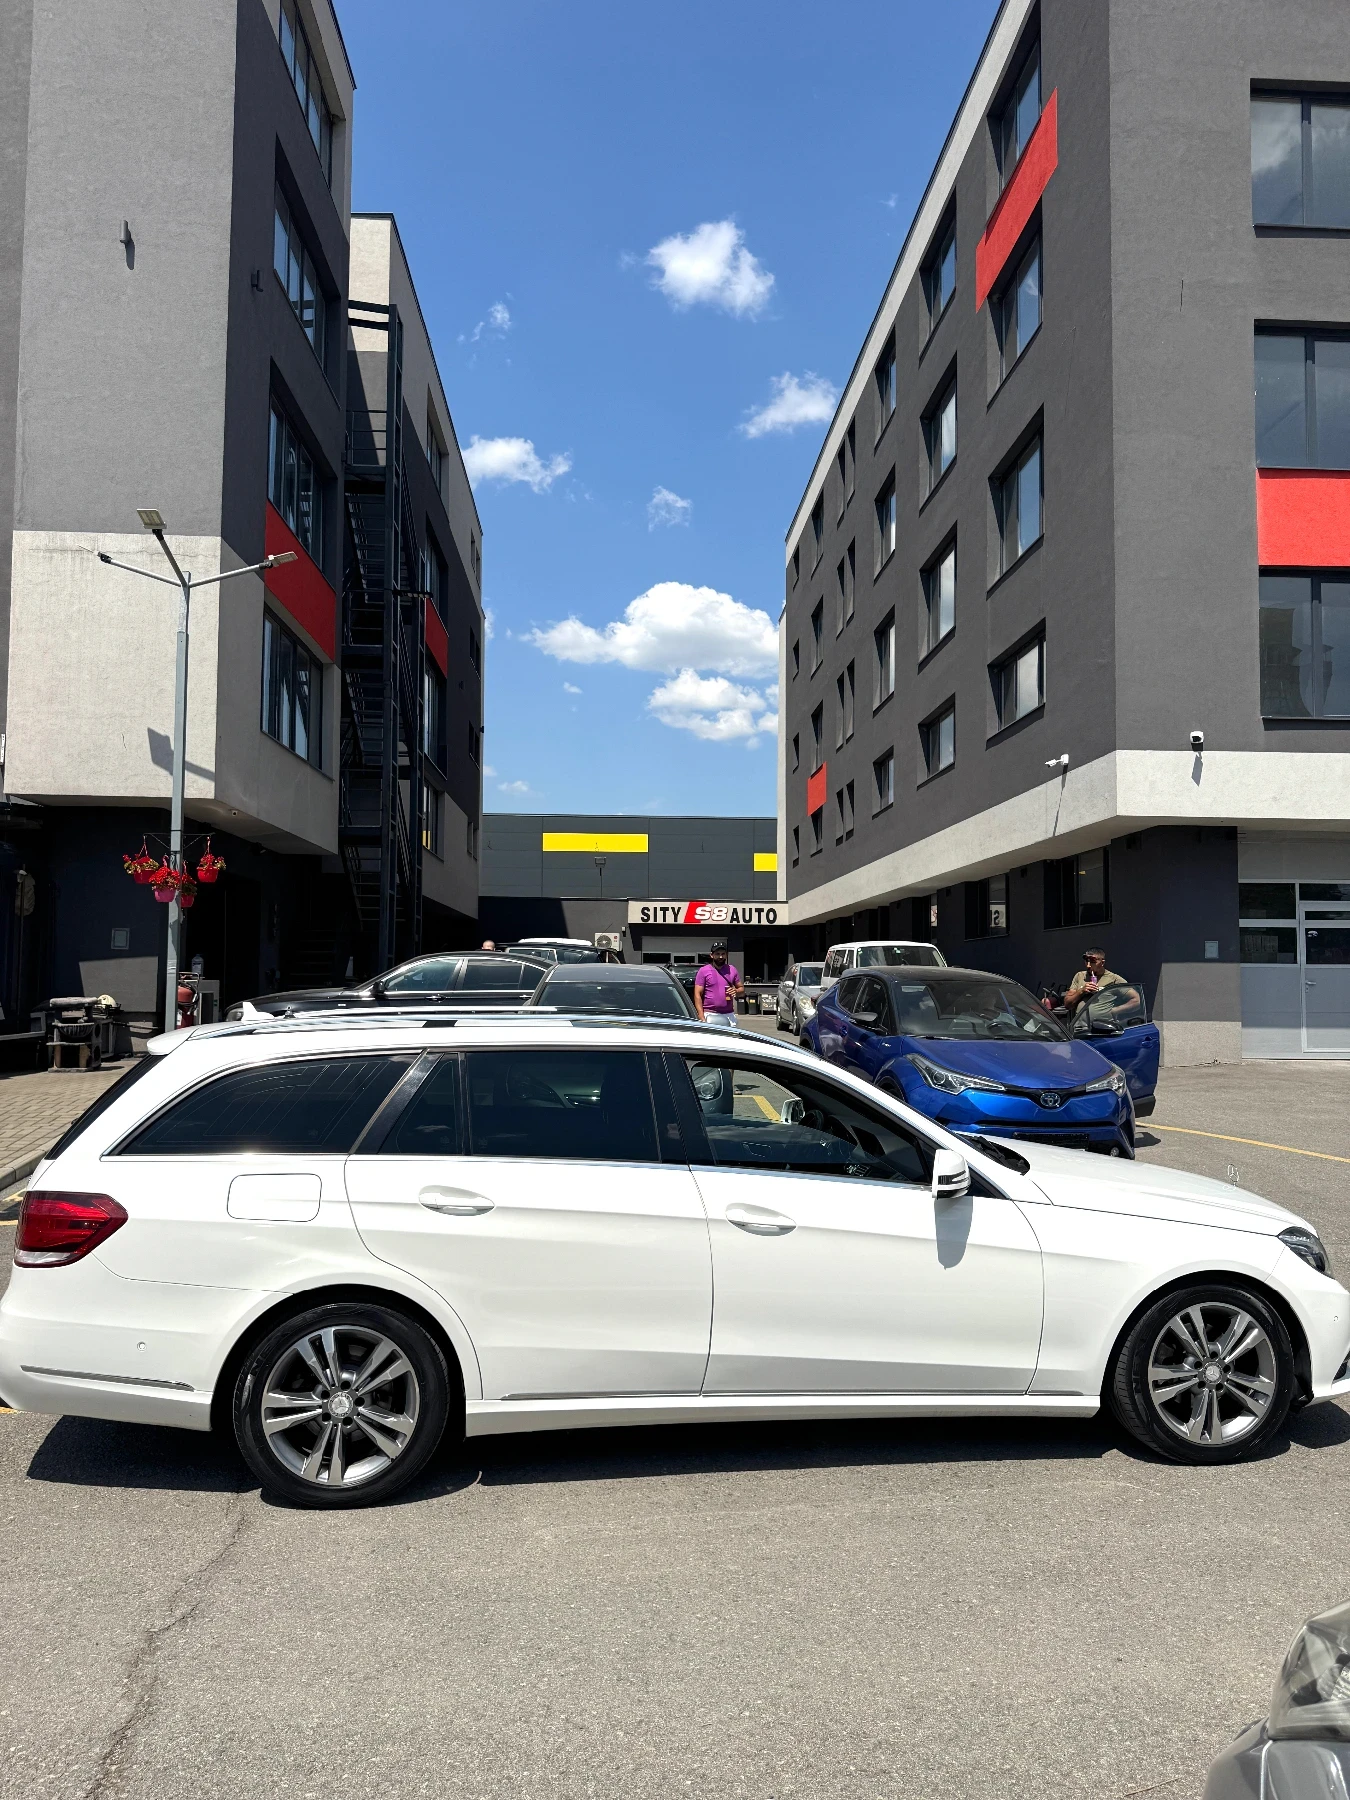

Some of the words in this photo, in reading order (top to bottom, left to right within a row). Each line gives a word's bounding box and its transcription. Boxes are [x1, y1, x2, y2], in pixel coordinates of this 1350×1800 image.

[641, 907, 681, 922] SITY
[694, 906, 728, 921] S8
[730, 908, 777, 924] AUTO
